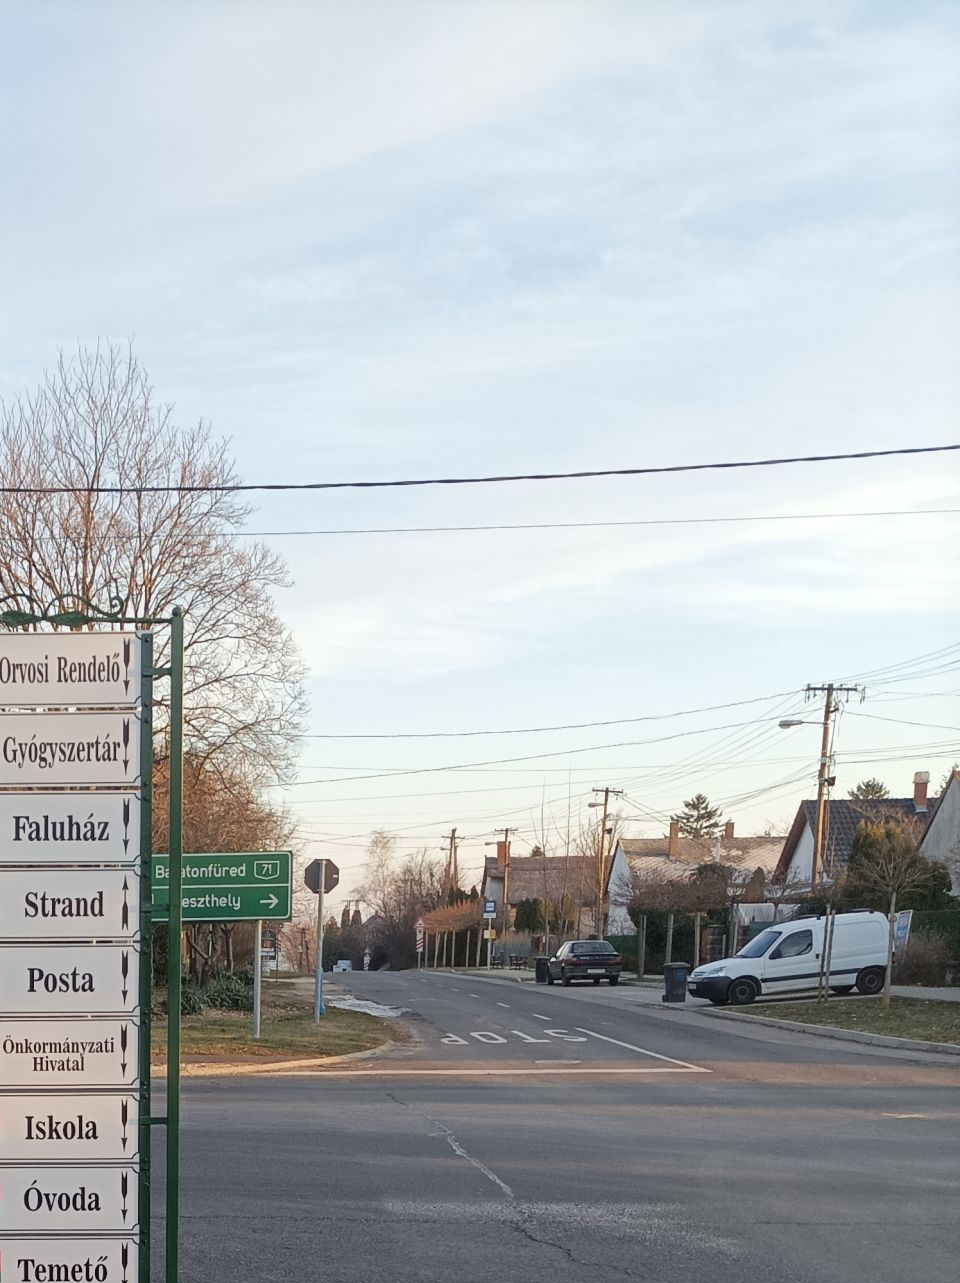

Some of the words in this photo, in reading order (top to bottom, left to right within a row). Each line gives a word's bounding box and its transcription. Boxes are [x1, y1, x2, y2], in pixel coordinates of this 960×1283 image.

[56, 653, 121, 684] Rendelő
[2, 734, 121, 768] Gyógyszertár
[12, 813, 110, 842] Faluház
[155, 863, 246, 879] Baatonfüred
[261, 864, 273, 875] 71
[24, 891, 105, 918] Strand
[182, 893, 241, 910] eszthely
[27, 967, 95, 993] Posta
[2, 1035, 115, 1059] Önkormányzati
[32, 1055, 86, 1072] Hivatal
[24, 1115, 99, 1140] Iskola
[23, 1180, 101, 1211] Óvoda
[17, 1256, 109, 1283] Temető
